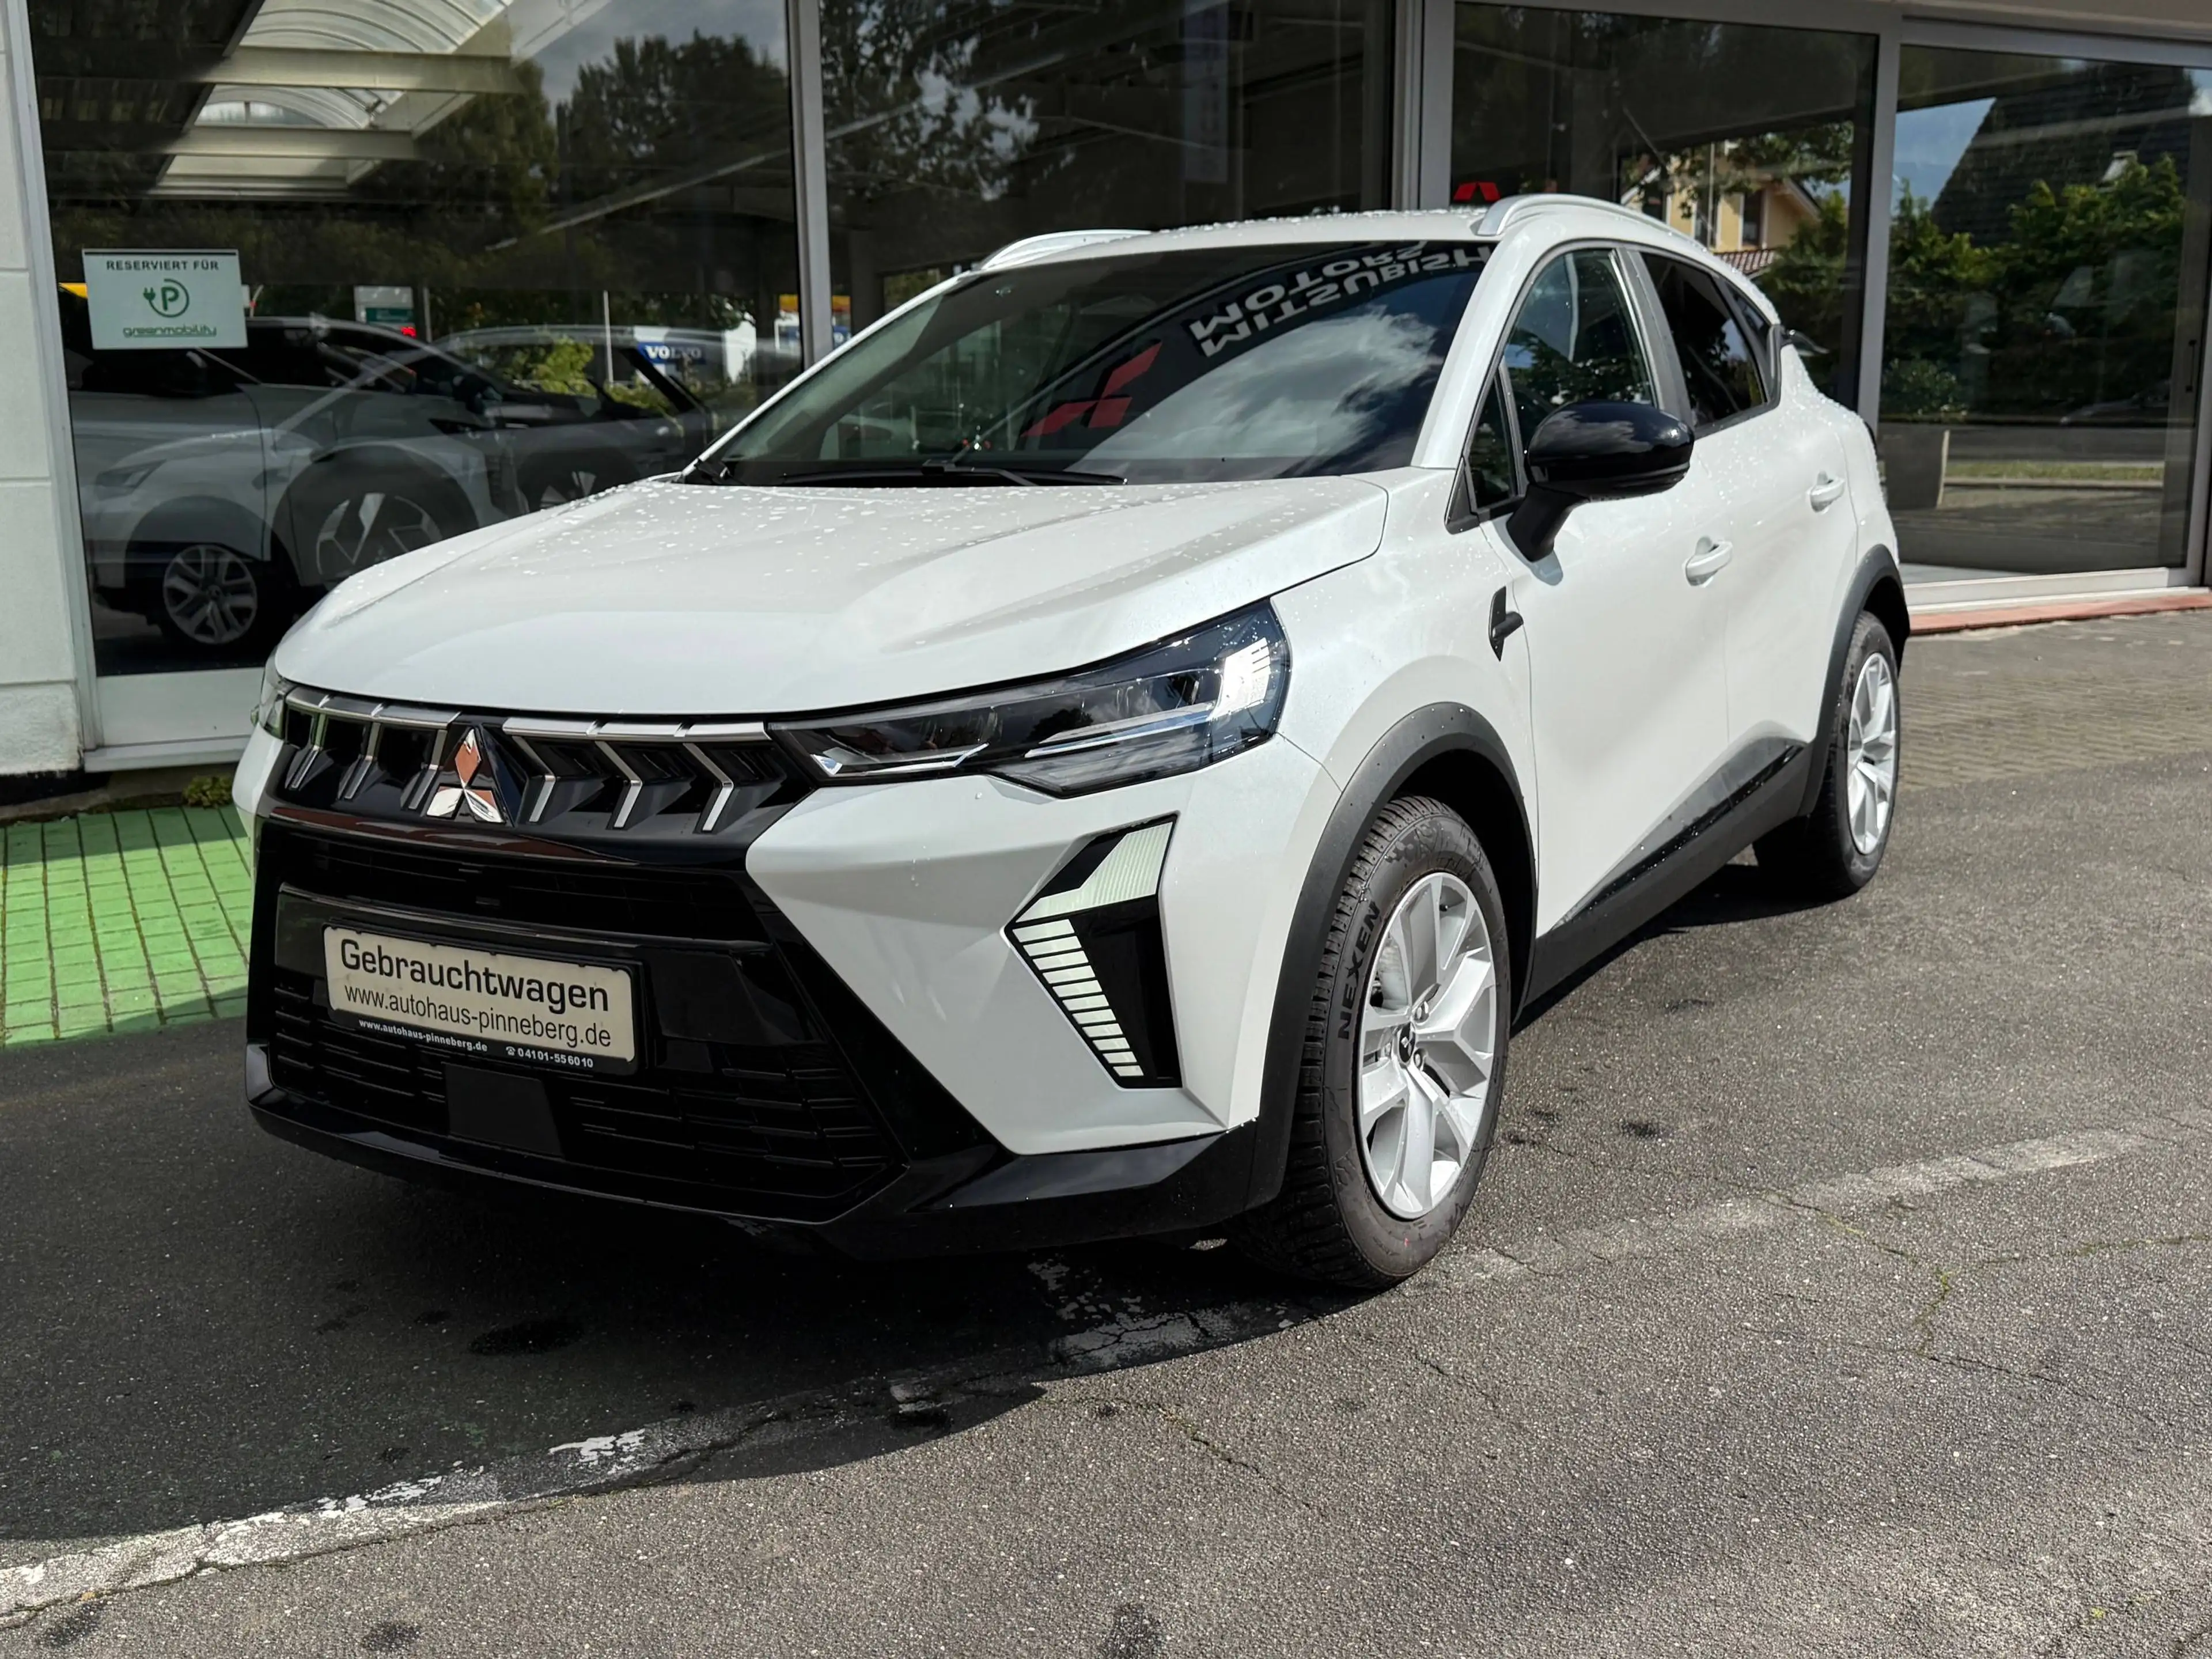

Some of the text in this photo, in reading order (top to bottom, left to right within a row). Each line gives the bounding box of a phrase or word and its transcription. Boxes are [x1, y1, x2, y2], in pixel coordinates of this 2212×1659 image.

[106, 259, 219, 271] RESERVIERT FÜR
[161, 286, 179, 312] P
[122, 323, 217, 338] greenmobility
[340, 938, 609, 1014] Gebrauchtwagen
[1338, 900, 1380, 1040] NEXEN
[344, 984, 612, 1048] www.autohaus-pinneberg.de
[358, 1019, 594, 1068] www.autohaus-pinneberg.de 04101-556010
